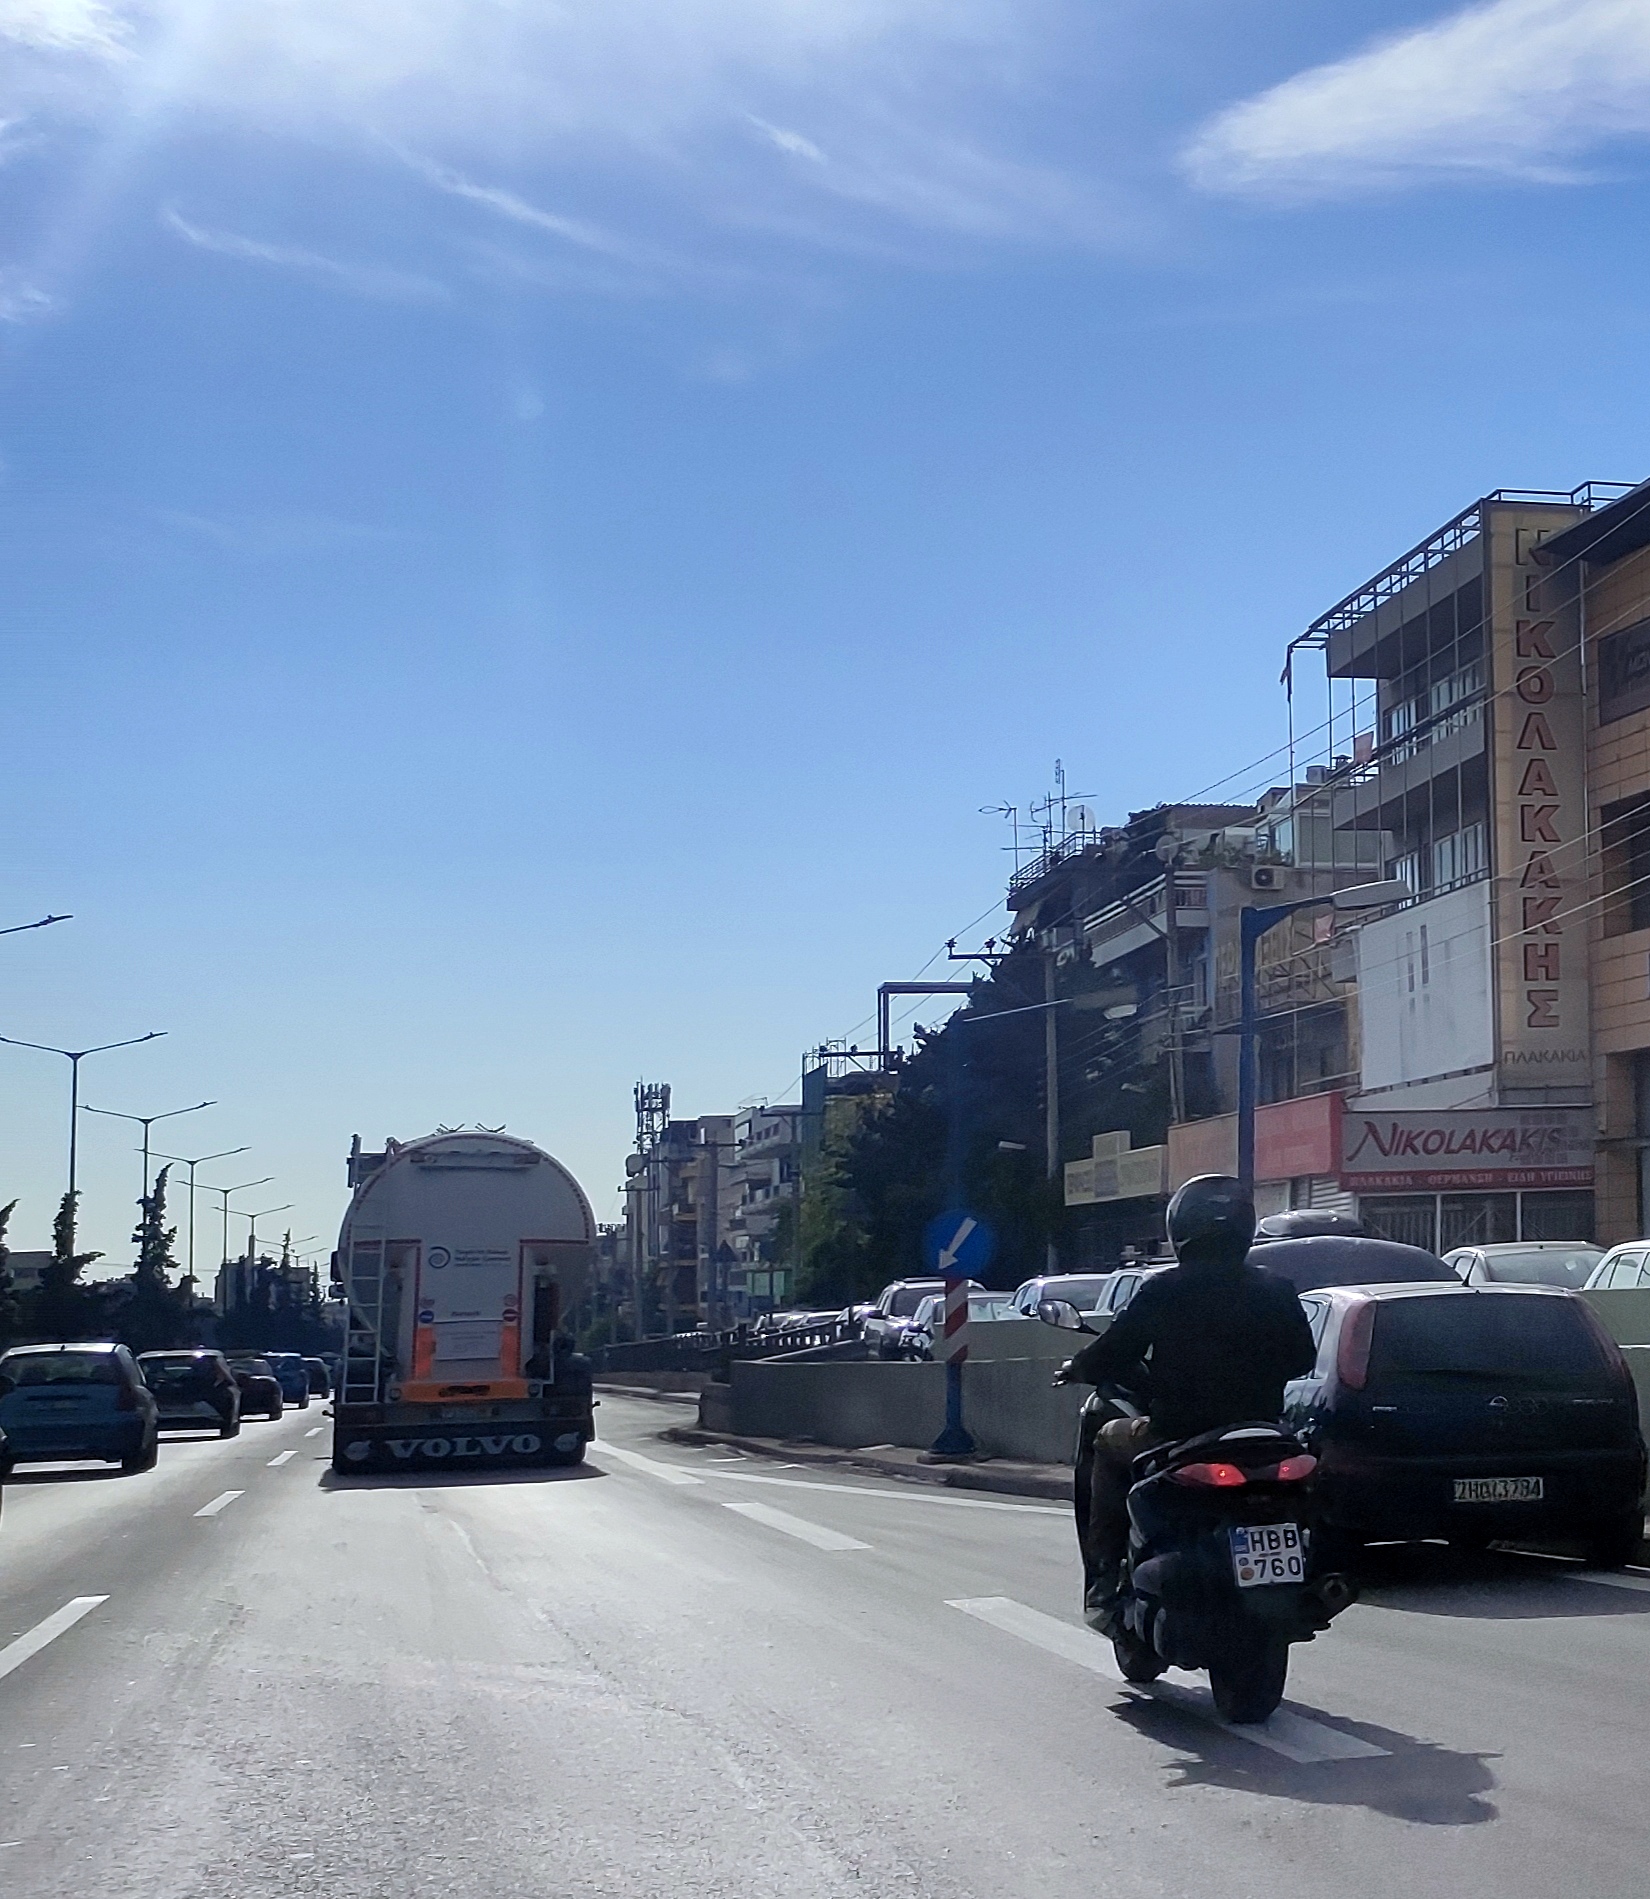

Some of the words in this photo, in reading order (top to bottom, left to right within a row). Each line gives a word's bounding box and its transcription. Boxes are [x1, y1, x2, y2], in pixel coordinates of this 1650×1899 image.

[1515, 527, 1564, 1028] ΝΙΚΟΛΑΚΑΚΗΣ
[1504, 1049, 1588, 1064] ΠΛΑΚΑΚΙΑ
[1345, 1120, 1562, 1163] NIKOLAKAKIS
[386, 1433, 542, 1458] VOLVO
[1249, 1528, 1298, 1552] HBB
[1253, 1555, 1302, 1579] 760
